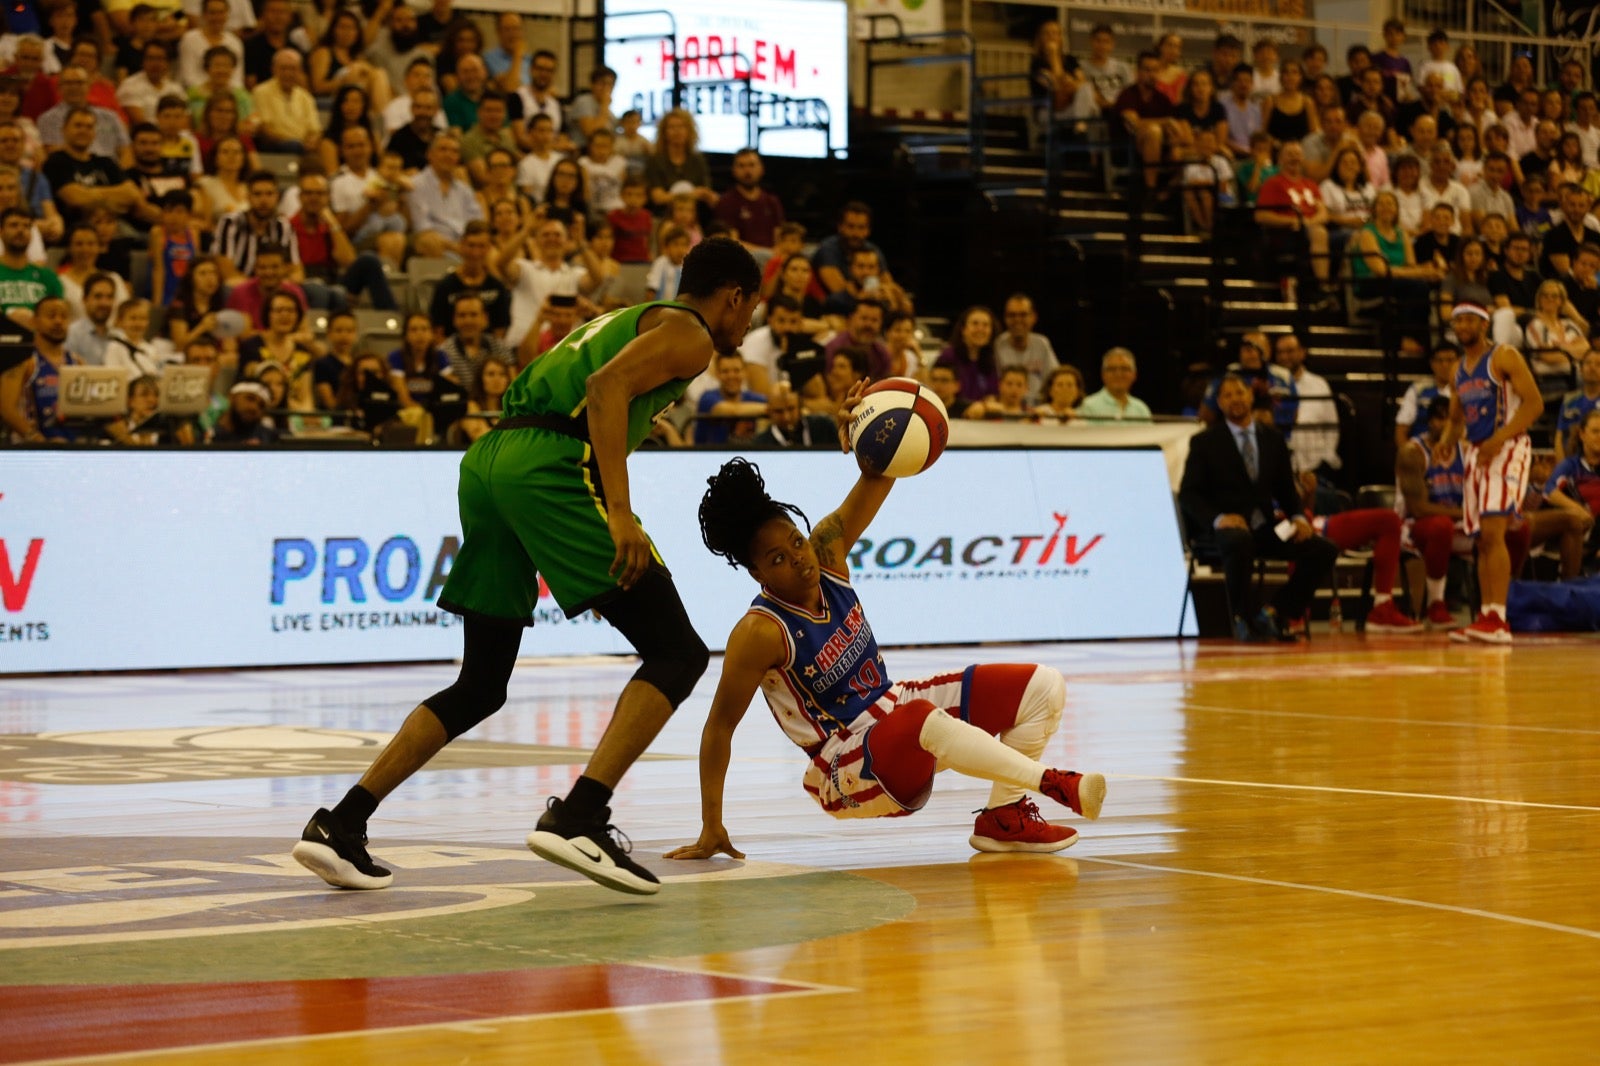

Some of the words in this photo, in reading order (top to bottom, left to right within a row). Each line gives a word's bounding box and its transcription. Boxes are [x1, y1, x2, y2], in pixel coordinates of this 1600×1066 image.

[660, 35, 796, 89] HARLEM
[270, 534, 461, 604] PROA
[848, 515, 1105, 569] ROACTIV
[271, 614, 312, 632] LIVE
[319, 610, 464, 631] ENTERTAINMEN
[815, 606, 864, 673] HARLEM
[848, 658, 882, 700] 10
